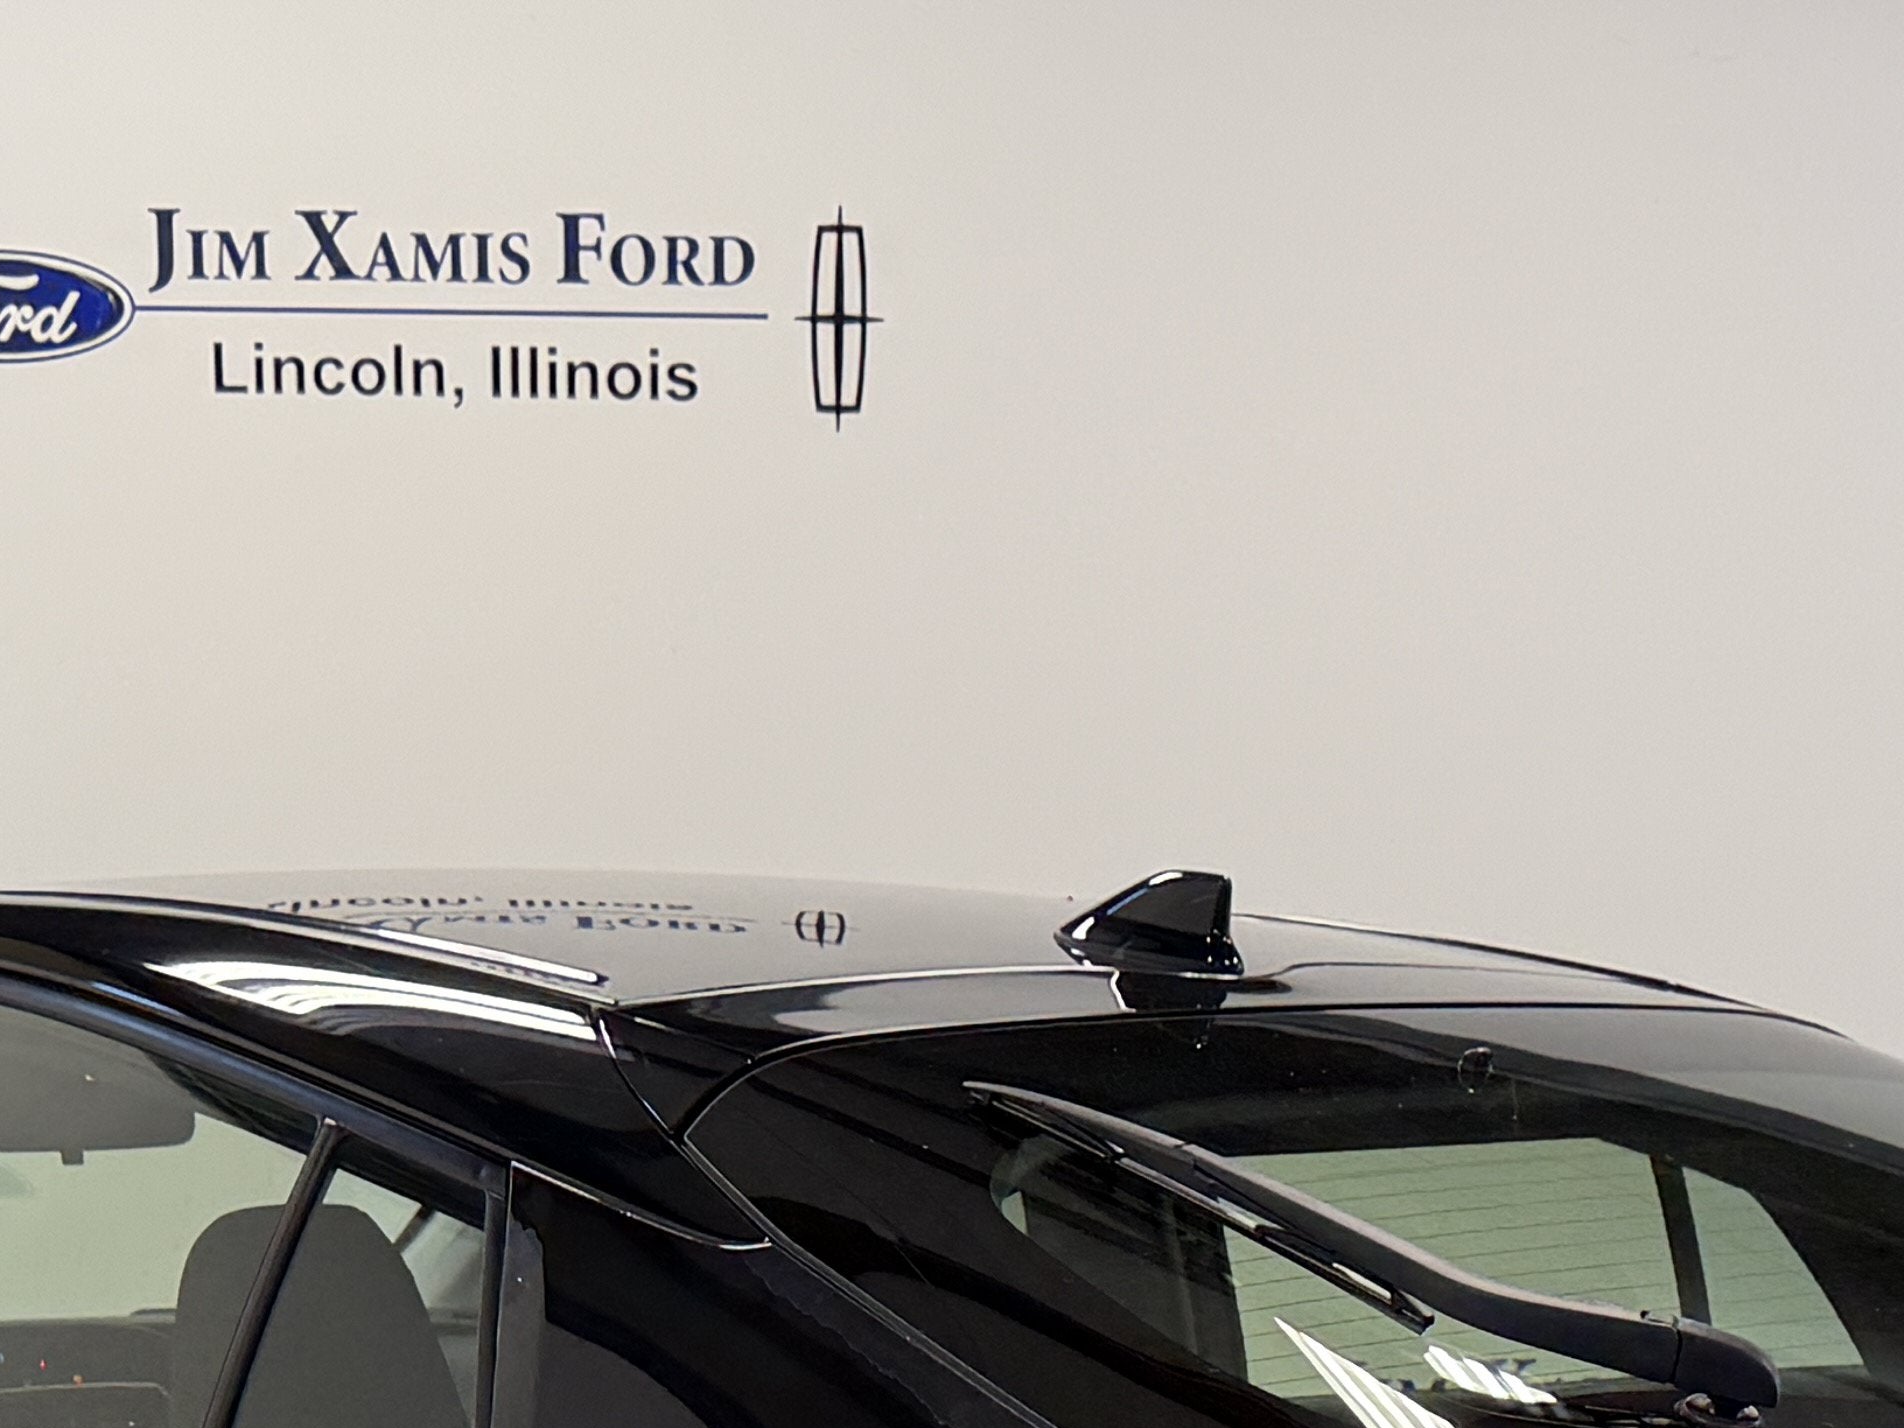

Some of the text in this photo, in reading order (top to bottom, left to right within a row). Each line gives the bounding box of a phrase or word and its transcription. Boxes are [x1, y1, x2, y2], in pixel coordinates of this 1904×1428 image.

[147, 208, 756, 293] JIM XAMIS FORD
[213, 342, 699, 408] Lincoln, Illinois
